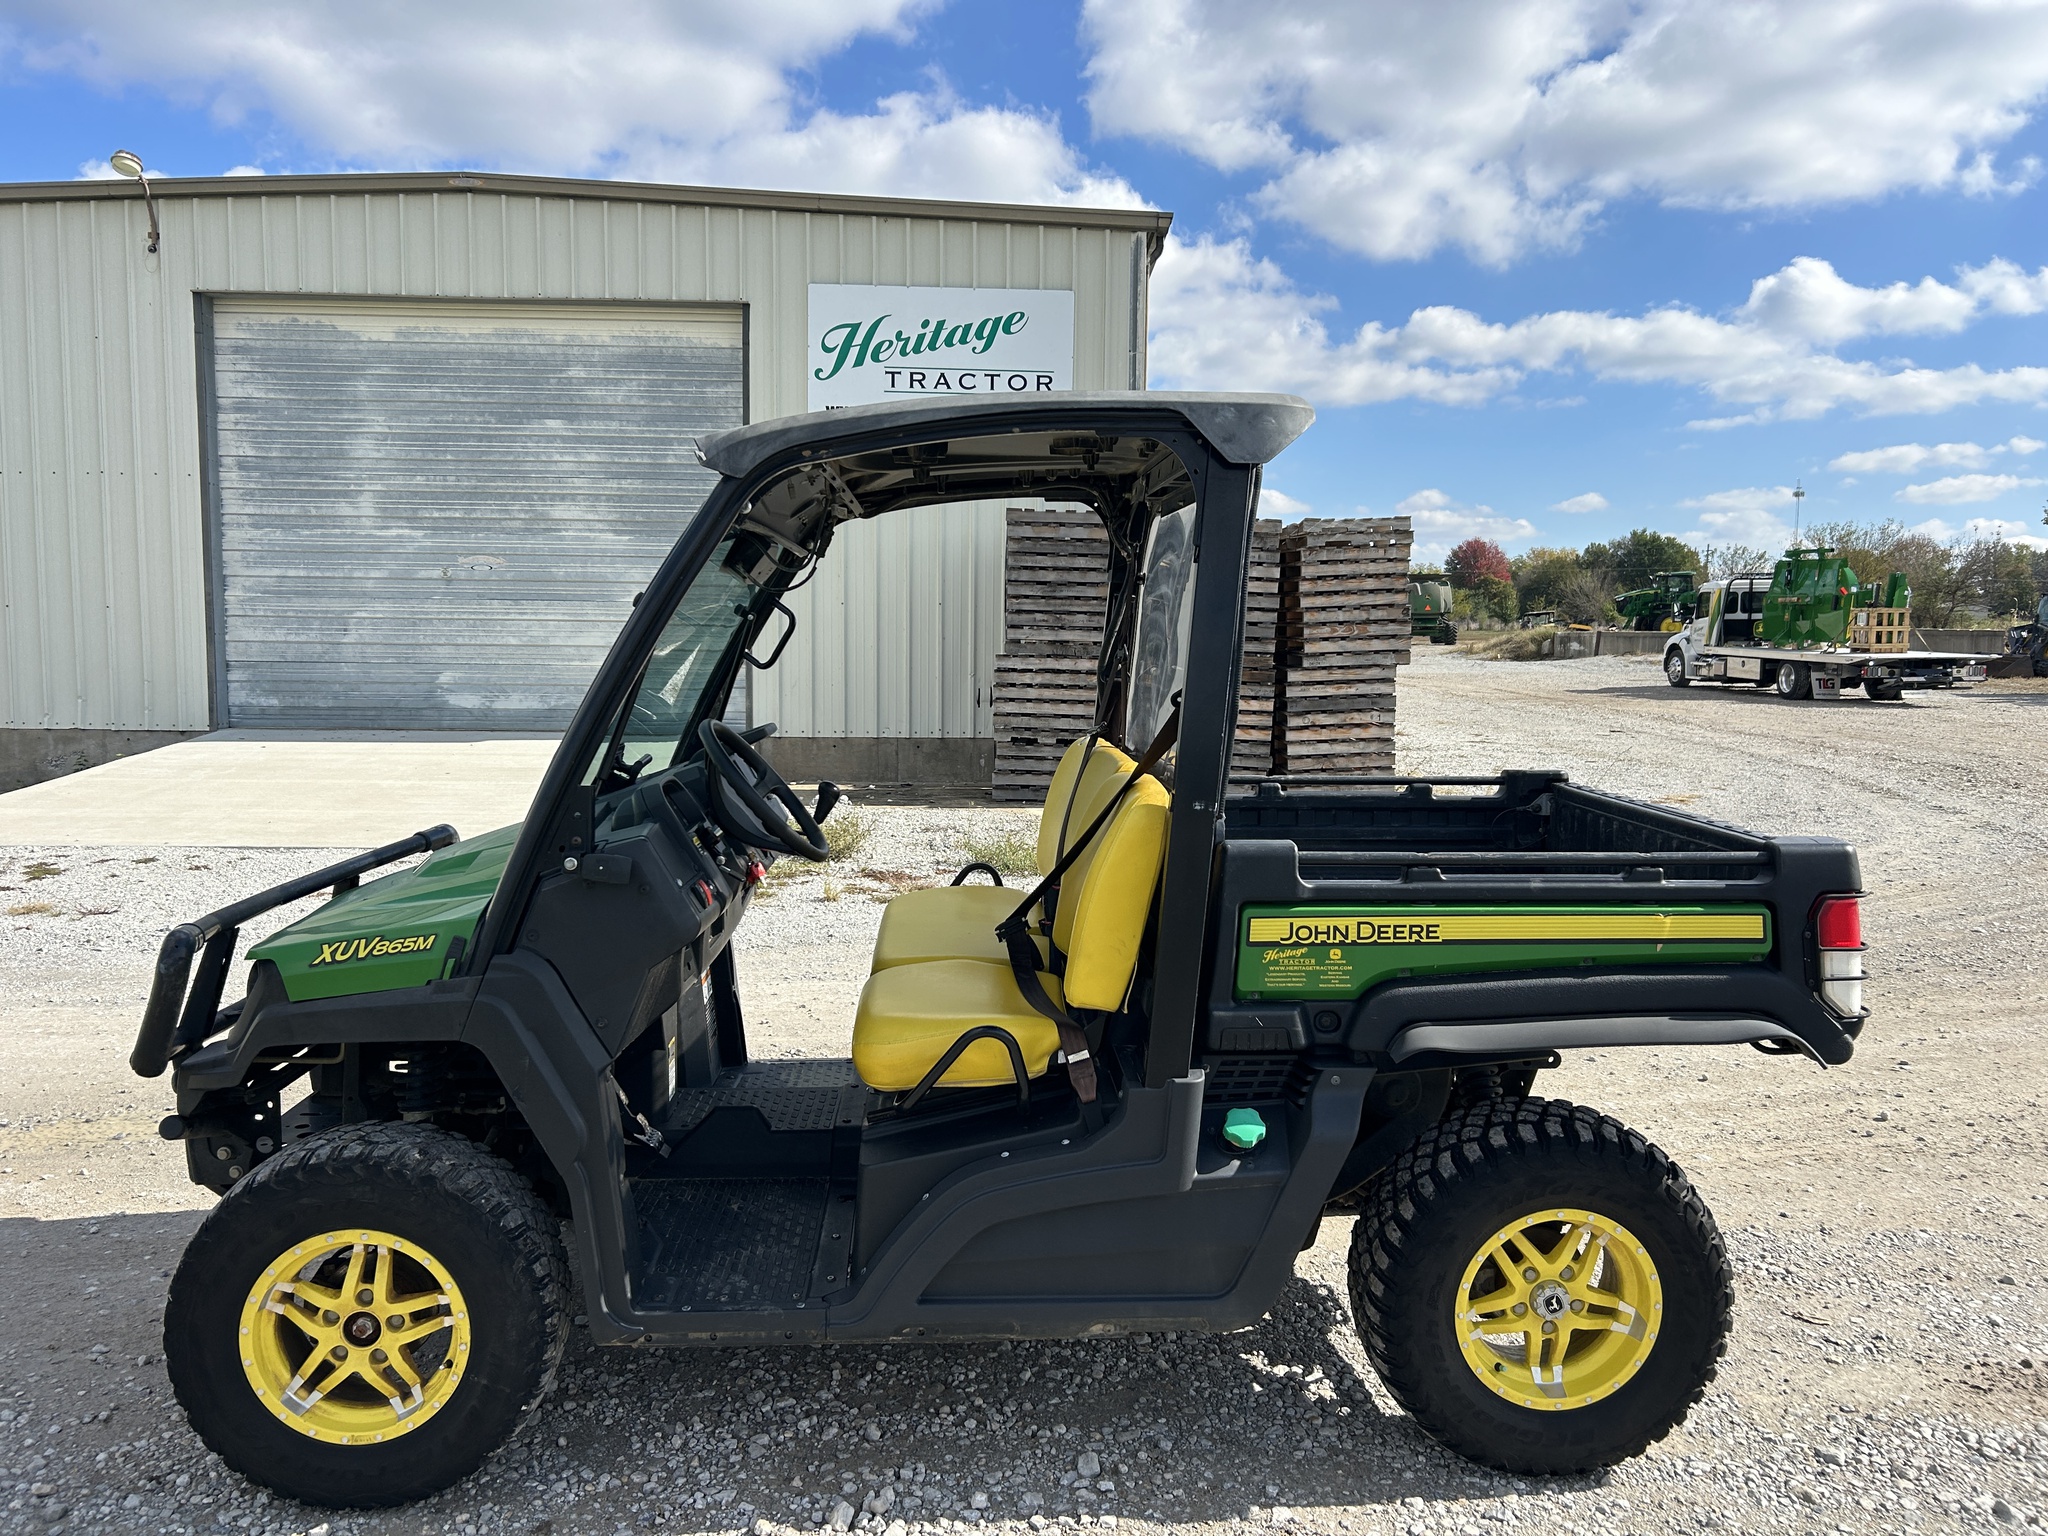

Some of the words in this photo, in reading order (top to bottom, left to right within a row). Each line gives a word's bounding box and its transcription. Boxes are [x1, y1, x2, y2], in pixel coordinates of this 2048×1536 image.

[814, 310, 1030, 381] Heritage
[884, 370, 1055, 392] TRACTOR
[1815, 678, 1836, 690] TLG
[1280, 921, 1350, 942] JOHN
[1356, 920, 1441, 941] DEERE
[311, 934, 437, 966] XUV865M
[1262, 947, 1309, 964] Heritage
